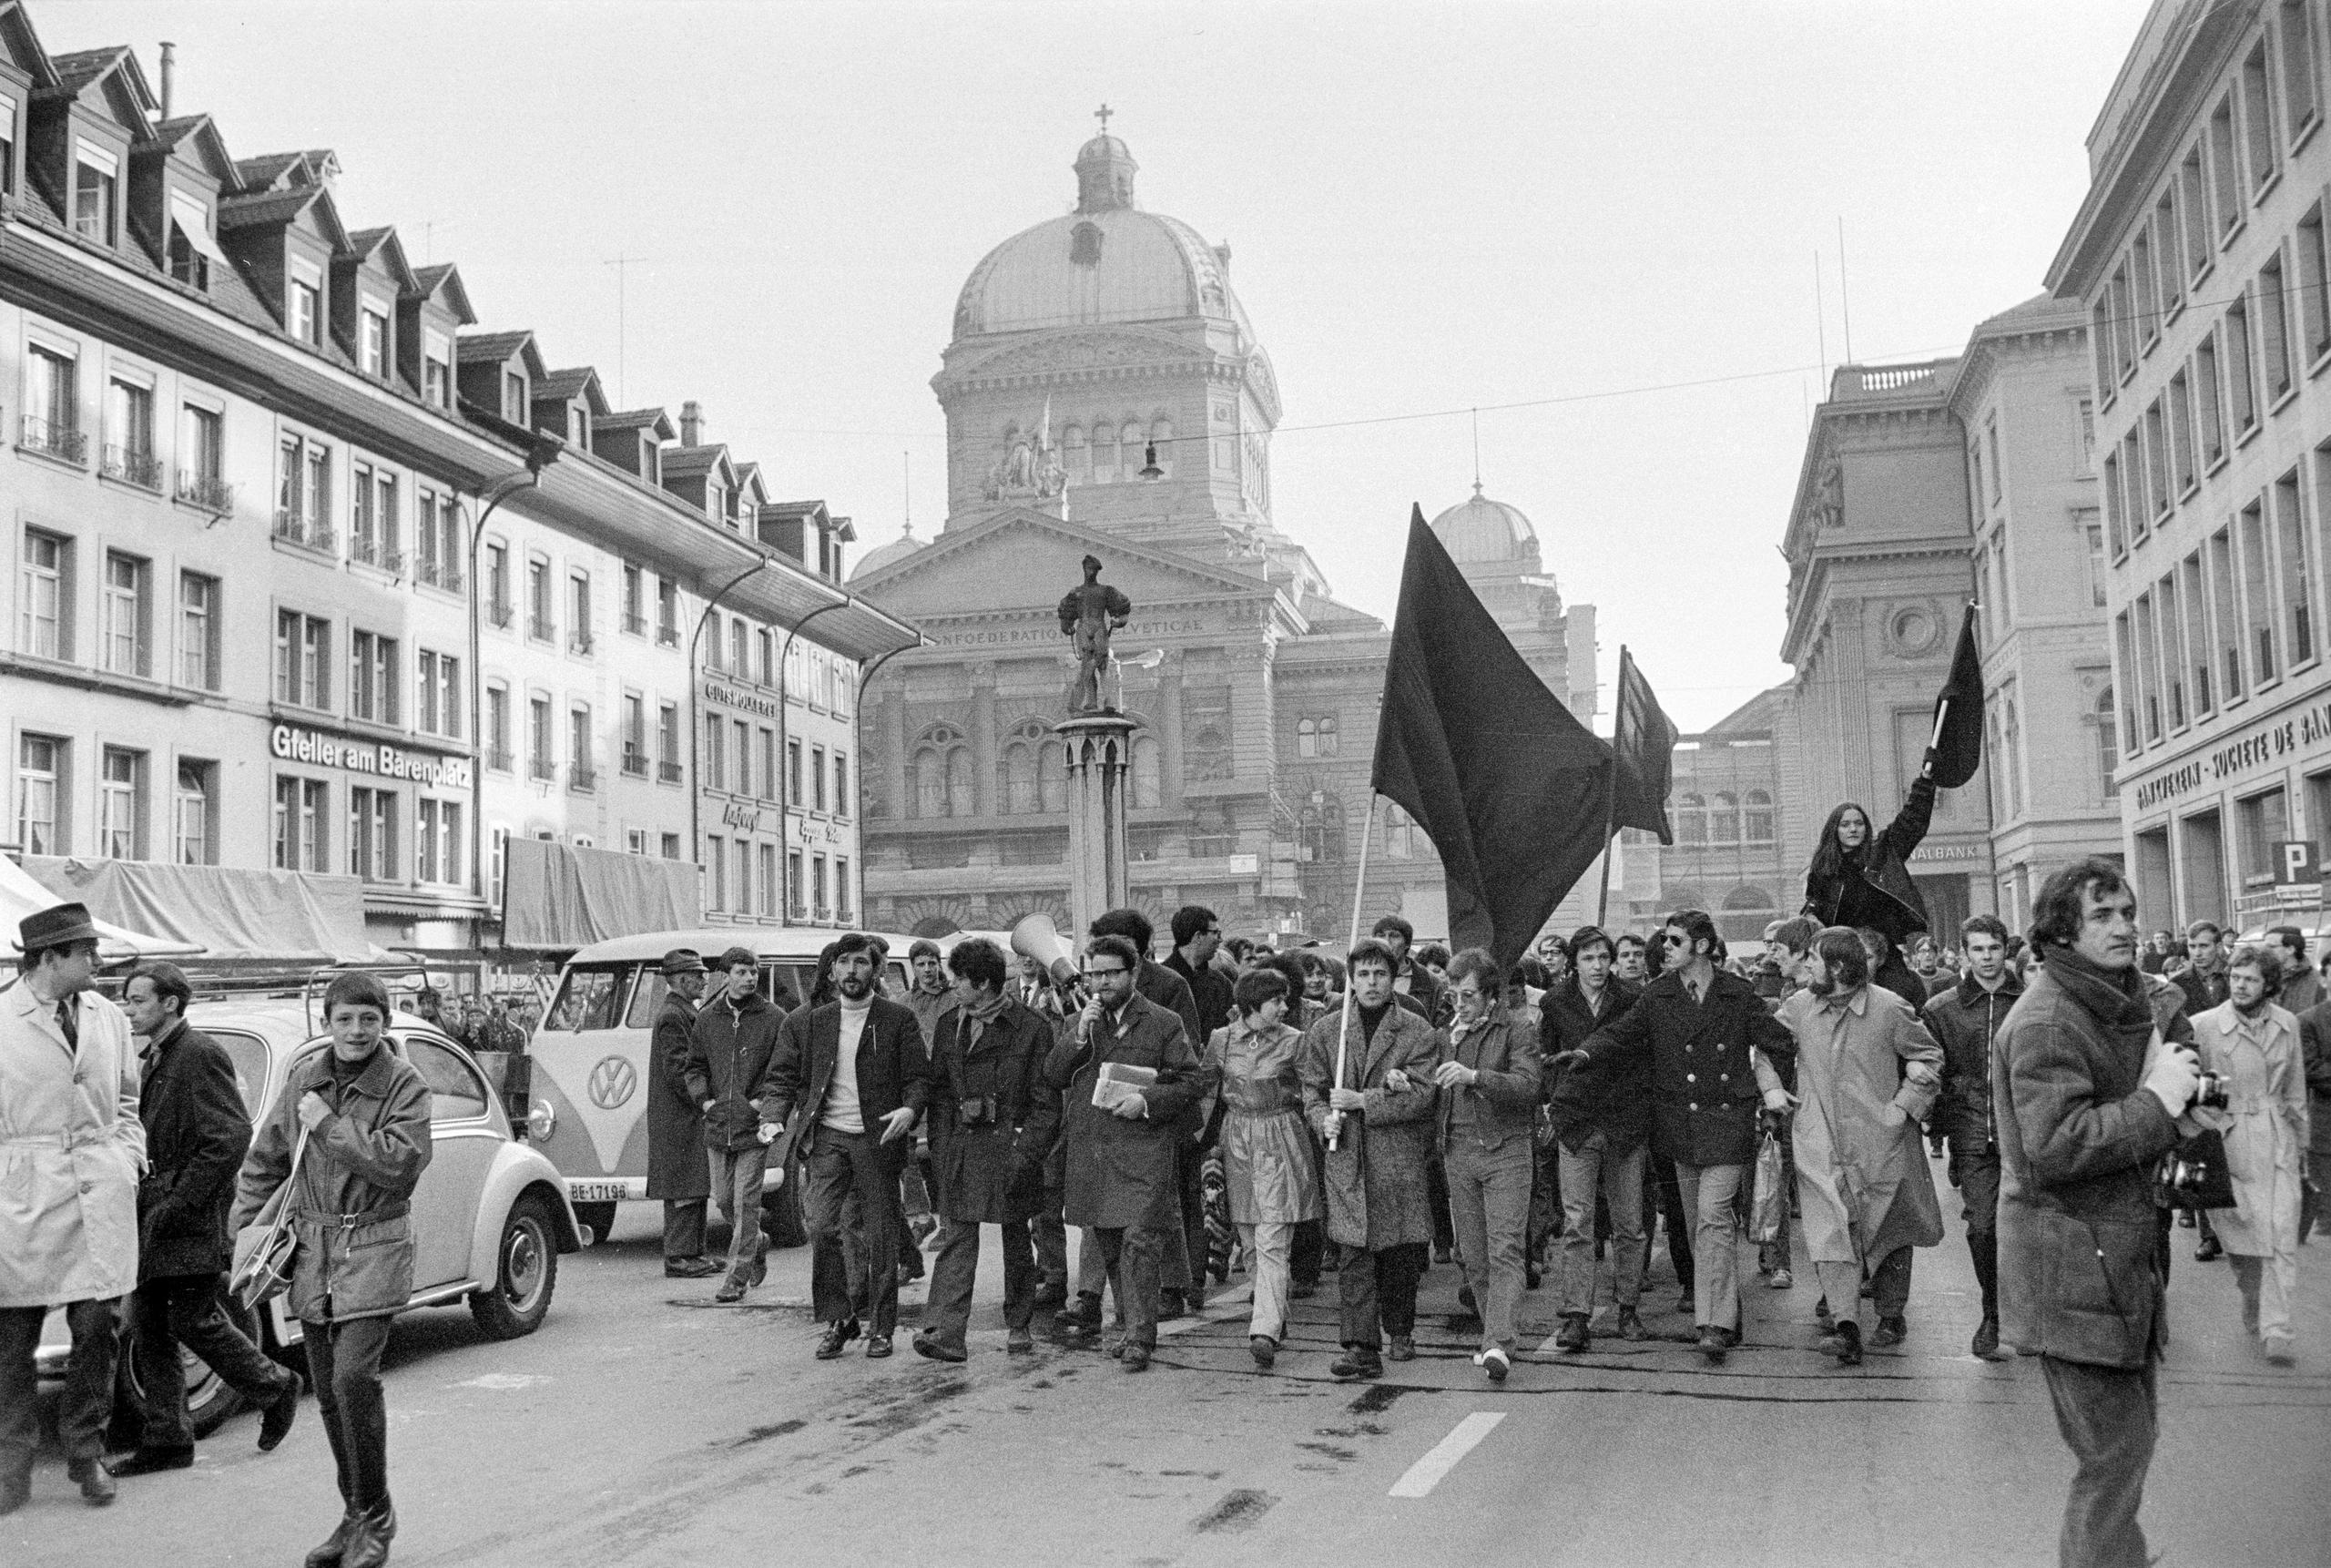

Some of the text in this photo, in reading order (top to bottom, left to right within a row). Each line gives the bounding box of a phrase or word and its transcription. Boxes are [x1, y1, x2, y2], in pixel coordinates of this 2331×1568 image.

[1112, 620, 1203, 636] ELVETICAE
[2274, 720, 2295, 755] DE
[274, 725, 473, 789] Gfeller am Bärenplatz
[1910, 846, 1976, 860] NALBANK
[2285, 843, 2307, 882] P
[590, 1056, 636, 1107] VW
